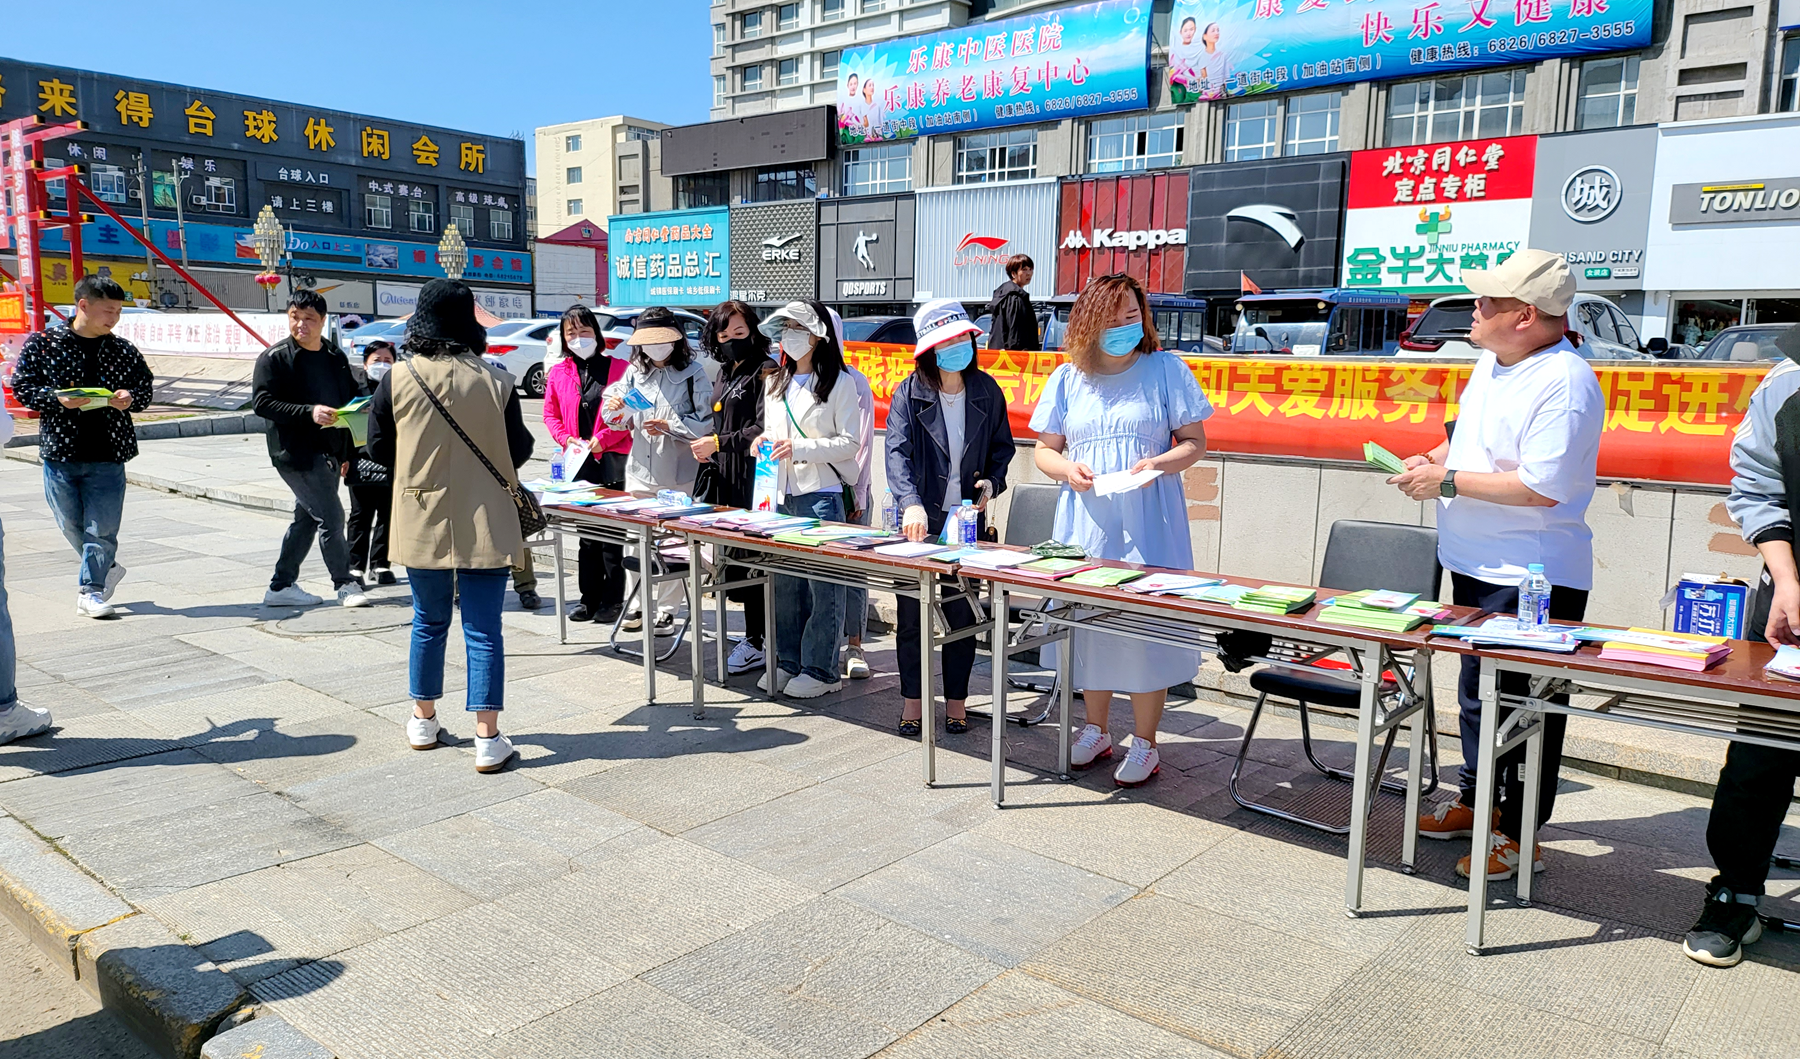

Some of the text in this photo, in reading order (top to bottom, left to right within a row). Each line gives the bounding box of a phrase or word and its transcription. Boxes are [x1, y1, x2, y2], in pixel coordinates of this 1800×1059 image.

[907, 23, 1065, 74] 乐康中医医院
[883, 57, 1090, 112] 乐康养老康复中心
[0, 74, 486, 174] 来得台球休闲会所
[1382, 143, 1505, 177] 北京同仁堂
[278, 167, 329, 184] 台球入口
[368, 179, 424, 199] 中式赛台
[1393, 173, 1487, 203] 定点专柜
[1571, 175, 1611, 212] 城
[271, 195, 335, 214] 请上三楼
[1700, 188, 1800, 213] TONLIO
[625, 223, 713, 244] 南京同仁堂药品大全
[1093, 228, 1187, 251] Kappa
[762, 250, 799, 260] ERKE
[1429, 241, 1521, 254] JINNIU PHARMACY
[1609, 249, 1642, 261] CITY
[615, 251, 721, 279] 诚信药品总汇
[954, 254, 1009, 266] LI-NING
[1346, 245, 1515, 286] 金牛大药
[843, 282, 887, 296] QDSPORTS
[149, 322, 164, 342] 自由
[167, 323, 182, 344] 平等
[204, 323, 221, 344] 法治
[225, 323, 241, 346] 爱国
[843, 346, 917, 399] 残疾
[1698, 604, 1717, 636] 苏打
